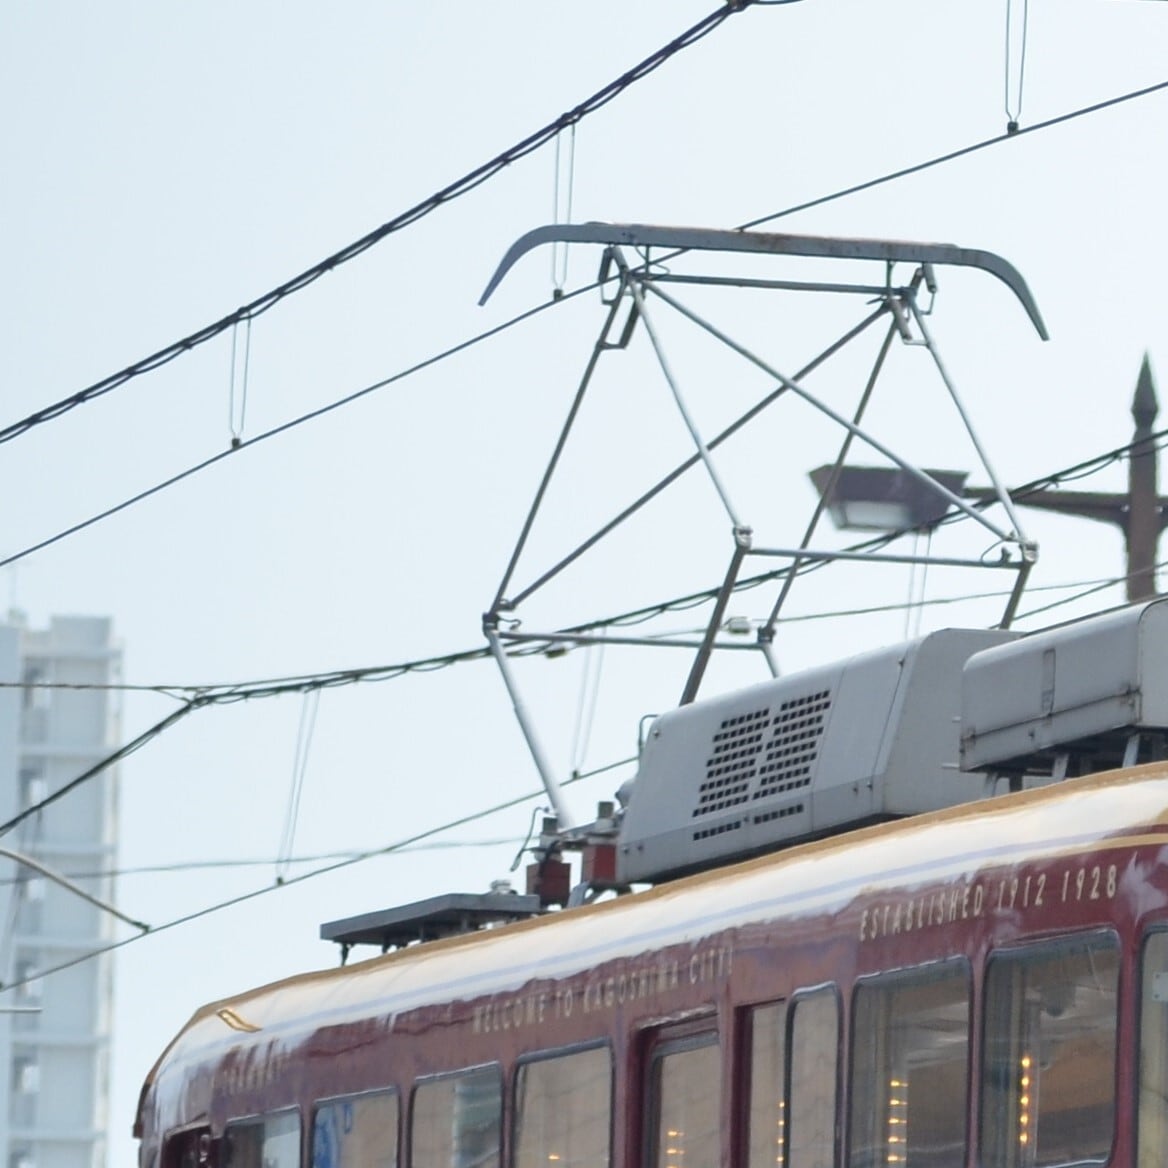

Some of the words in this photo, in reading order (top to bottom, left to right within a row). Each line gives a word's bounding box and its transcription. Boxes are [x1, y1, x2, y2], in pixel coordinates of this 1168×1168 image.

[860, 884, 984, 941] ESTABLISHED
[1000, 873, 1046, 909] 1912
[1062, 864, 1118, 902] 1928
